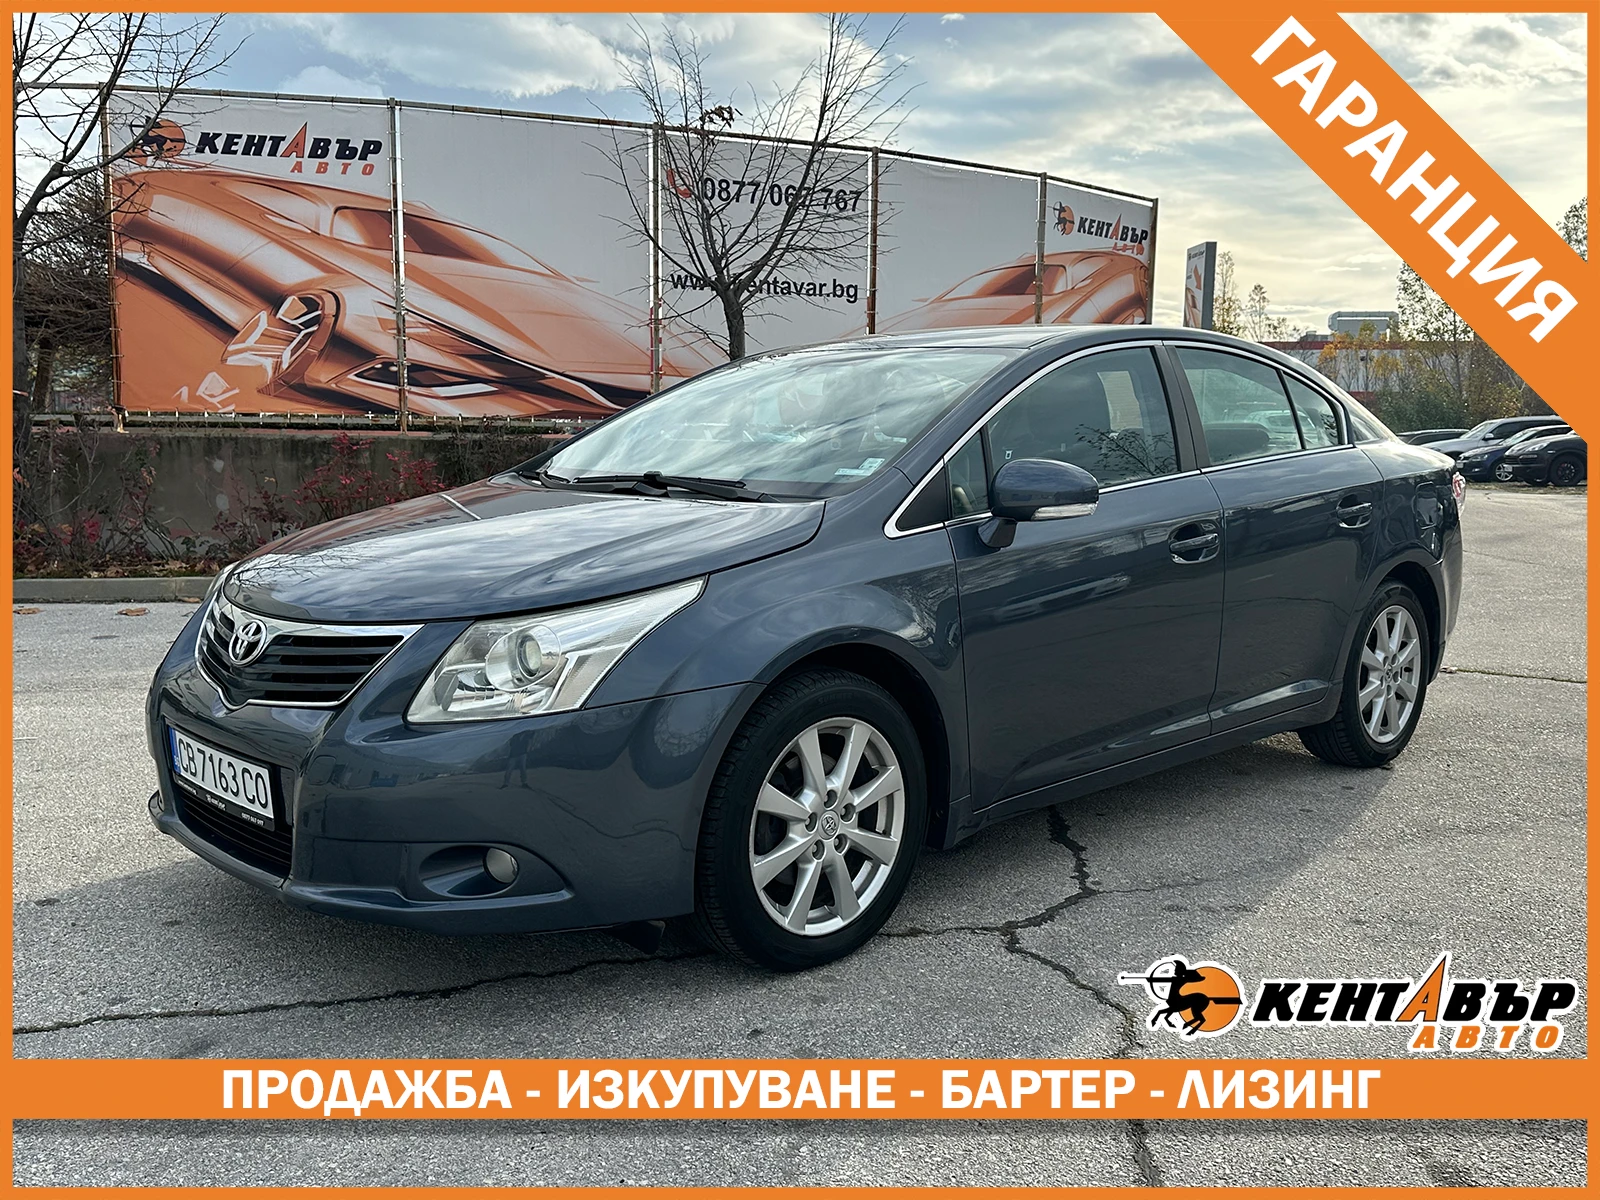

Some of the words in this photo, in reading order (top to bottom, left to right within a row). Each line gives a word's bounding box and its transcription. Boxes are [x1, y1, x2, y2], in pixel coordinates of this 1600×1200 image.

[195, 121, 383, 161] КЕНТАВЪР
[290, 160, 375, 176] АВТО
[703, 177, 760, 204] 0877
[819, 187, 864, 212] 767
[1077, 212, 1149, 245] КЕНТАВЪР
